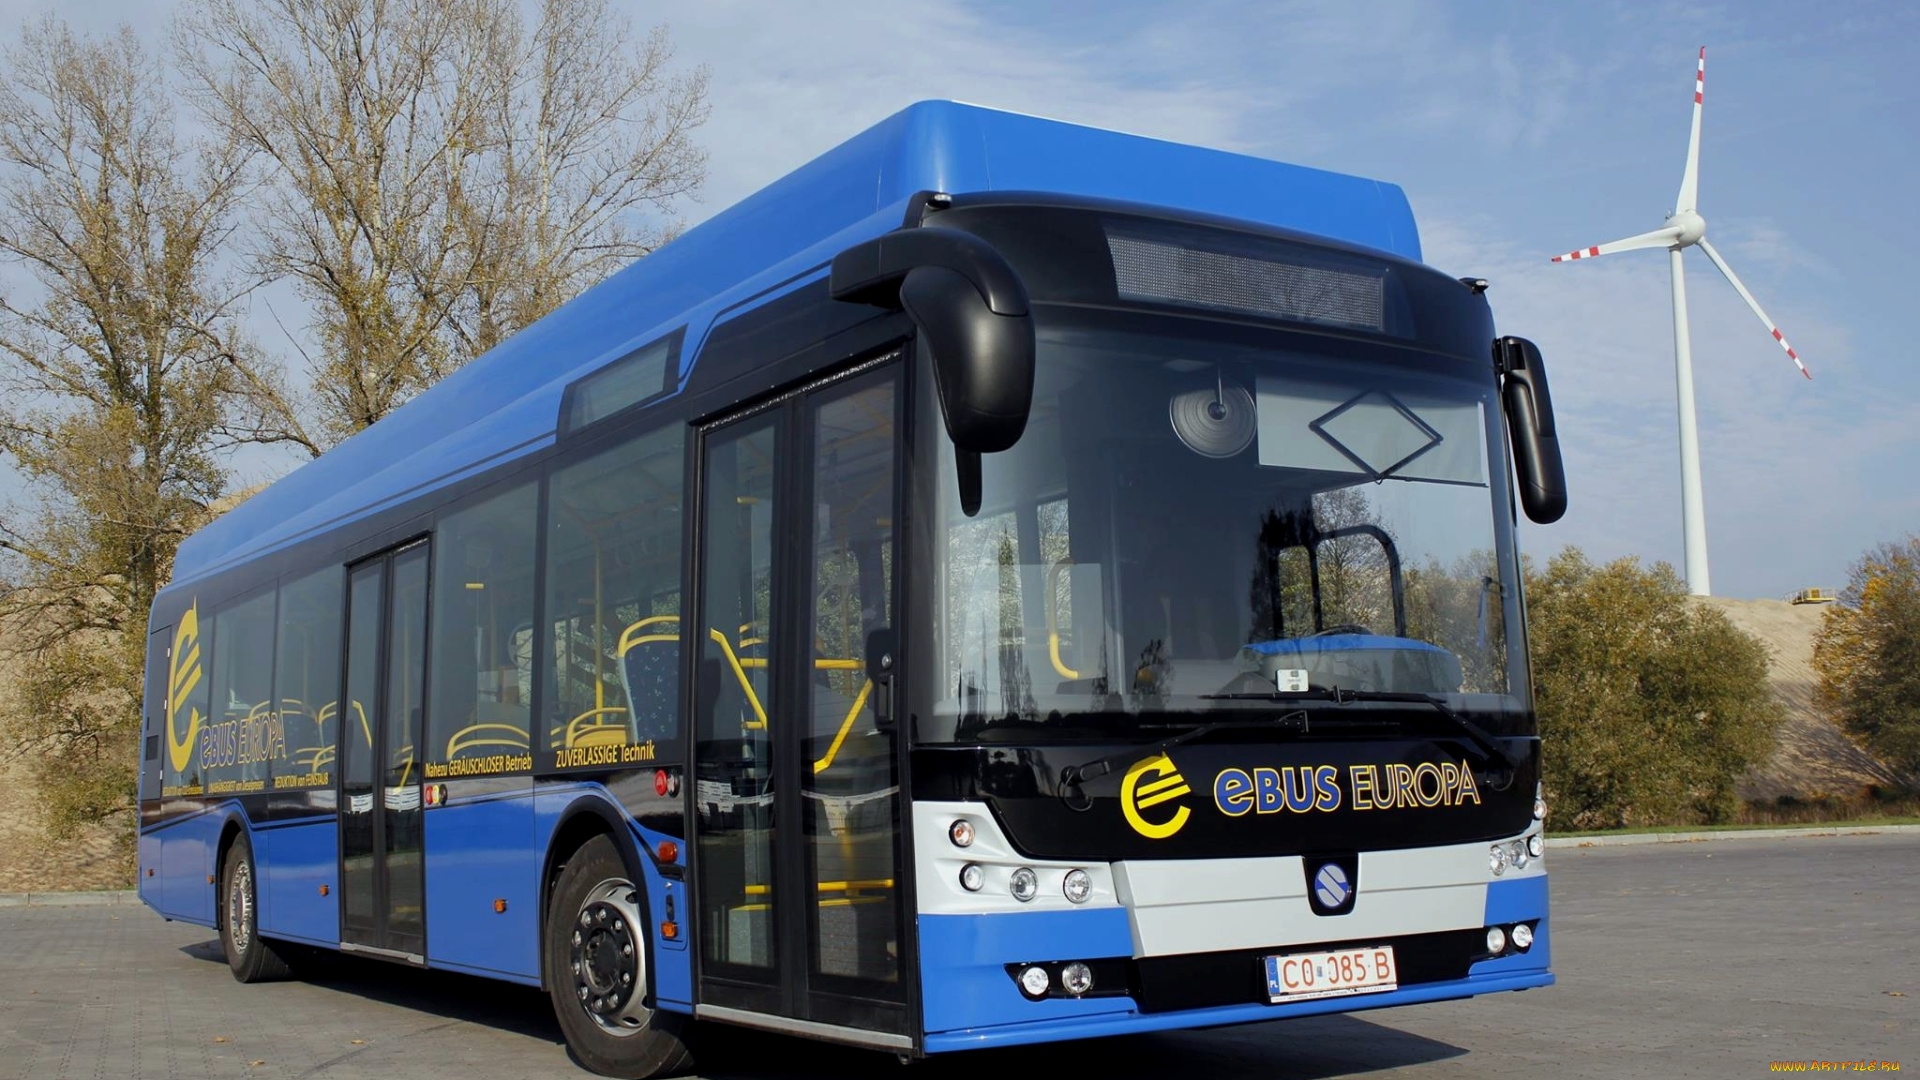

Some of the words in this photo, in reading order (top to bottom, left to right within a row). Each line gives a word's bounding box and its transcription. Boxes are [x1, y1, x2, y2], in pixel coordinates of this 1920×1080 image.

[238, 708, 286, 764] EUROPA
[425, 761, 448, 777] Nahezu
[505, 751, 532, 771] Betrieb
[620, 740, 655, 762] Technik
[1213, 765, 1341, 816] eBUS
[1350, 759, 1481, 811] EUROPA
[1375, 951, 1390, 980] B
[1270, 980, 1278, 988] PL
